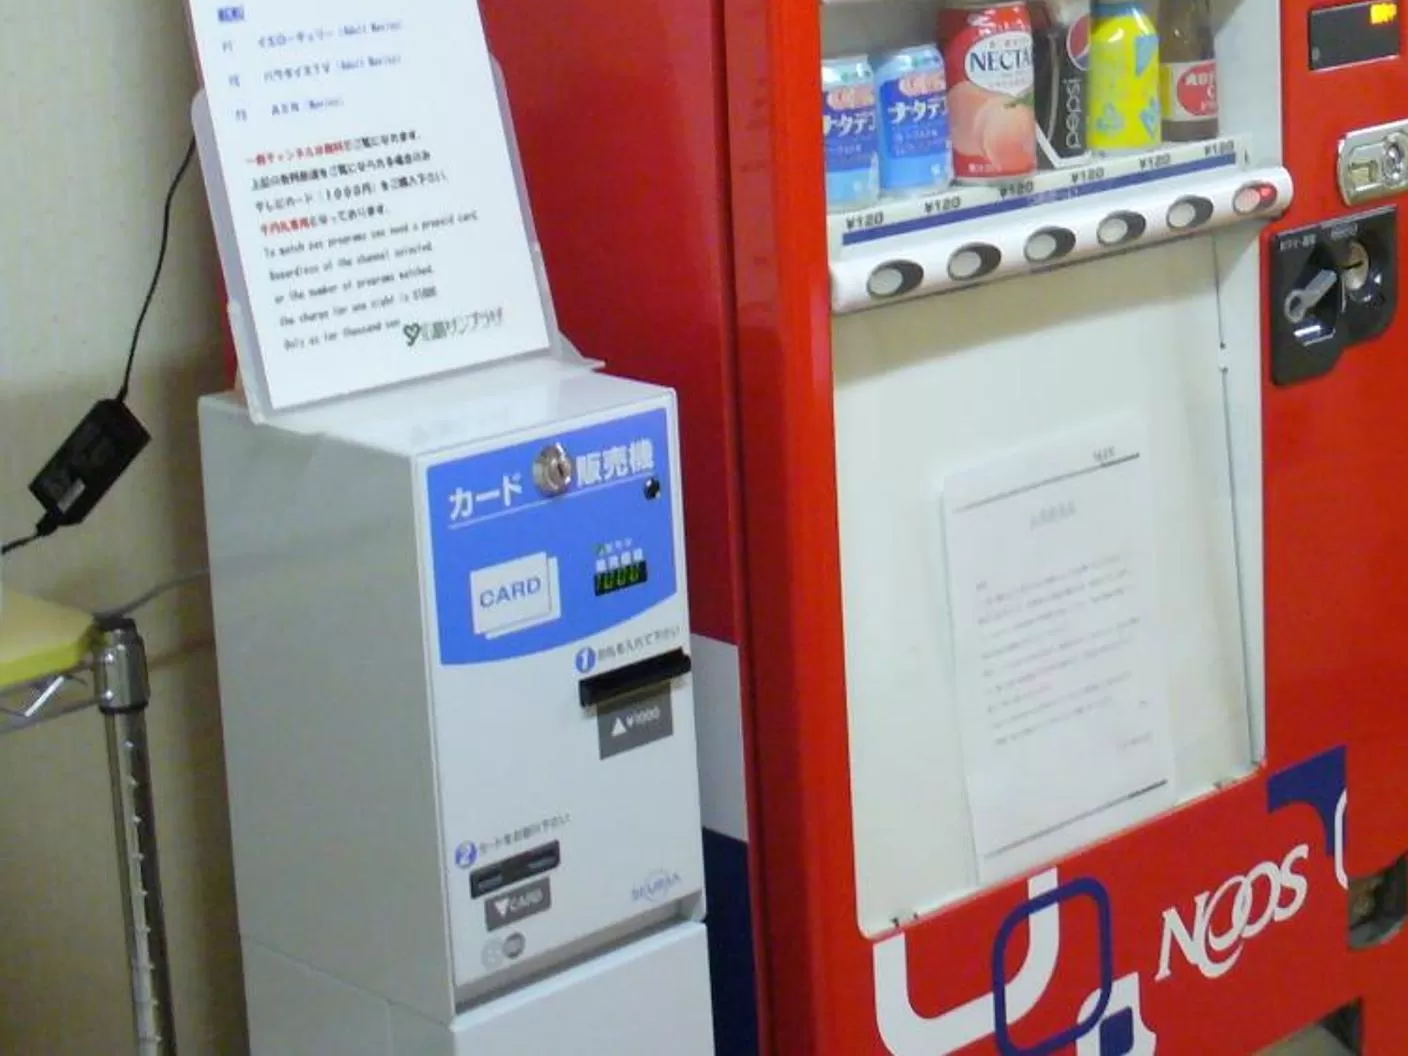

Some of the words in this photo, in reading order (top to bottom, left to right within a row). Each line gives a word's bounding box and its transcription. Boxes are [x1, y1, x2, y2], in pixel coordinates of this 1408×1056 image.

[1061, 77, 1082, 149] pepsi
[1139, 153, 1171, 171] ¥120
[1072, 167, 1104, 185] ¥120
[1001, 181, 1035, 199] ¥120
[925, 195, 962, 214] ¥120
[846, 211, 885, 231] ¥120
[449, 471, 524, 521] カード
[575, 437, 656, 488] 販売機
[479, 576, 542, 609] CARD
[1155, 843, 1309, 980] NOOS
